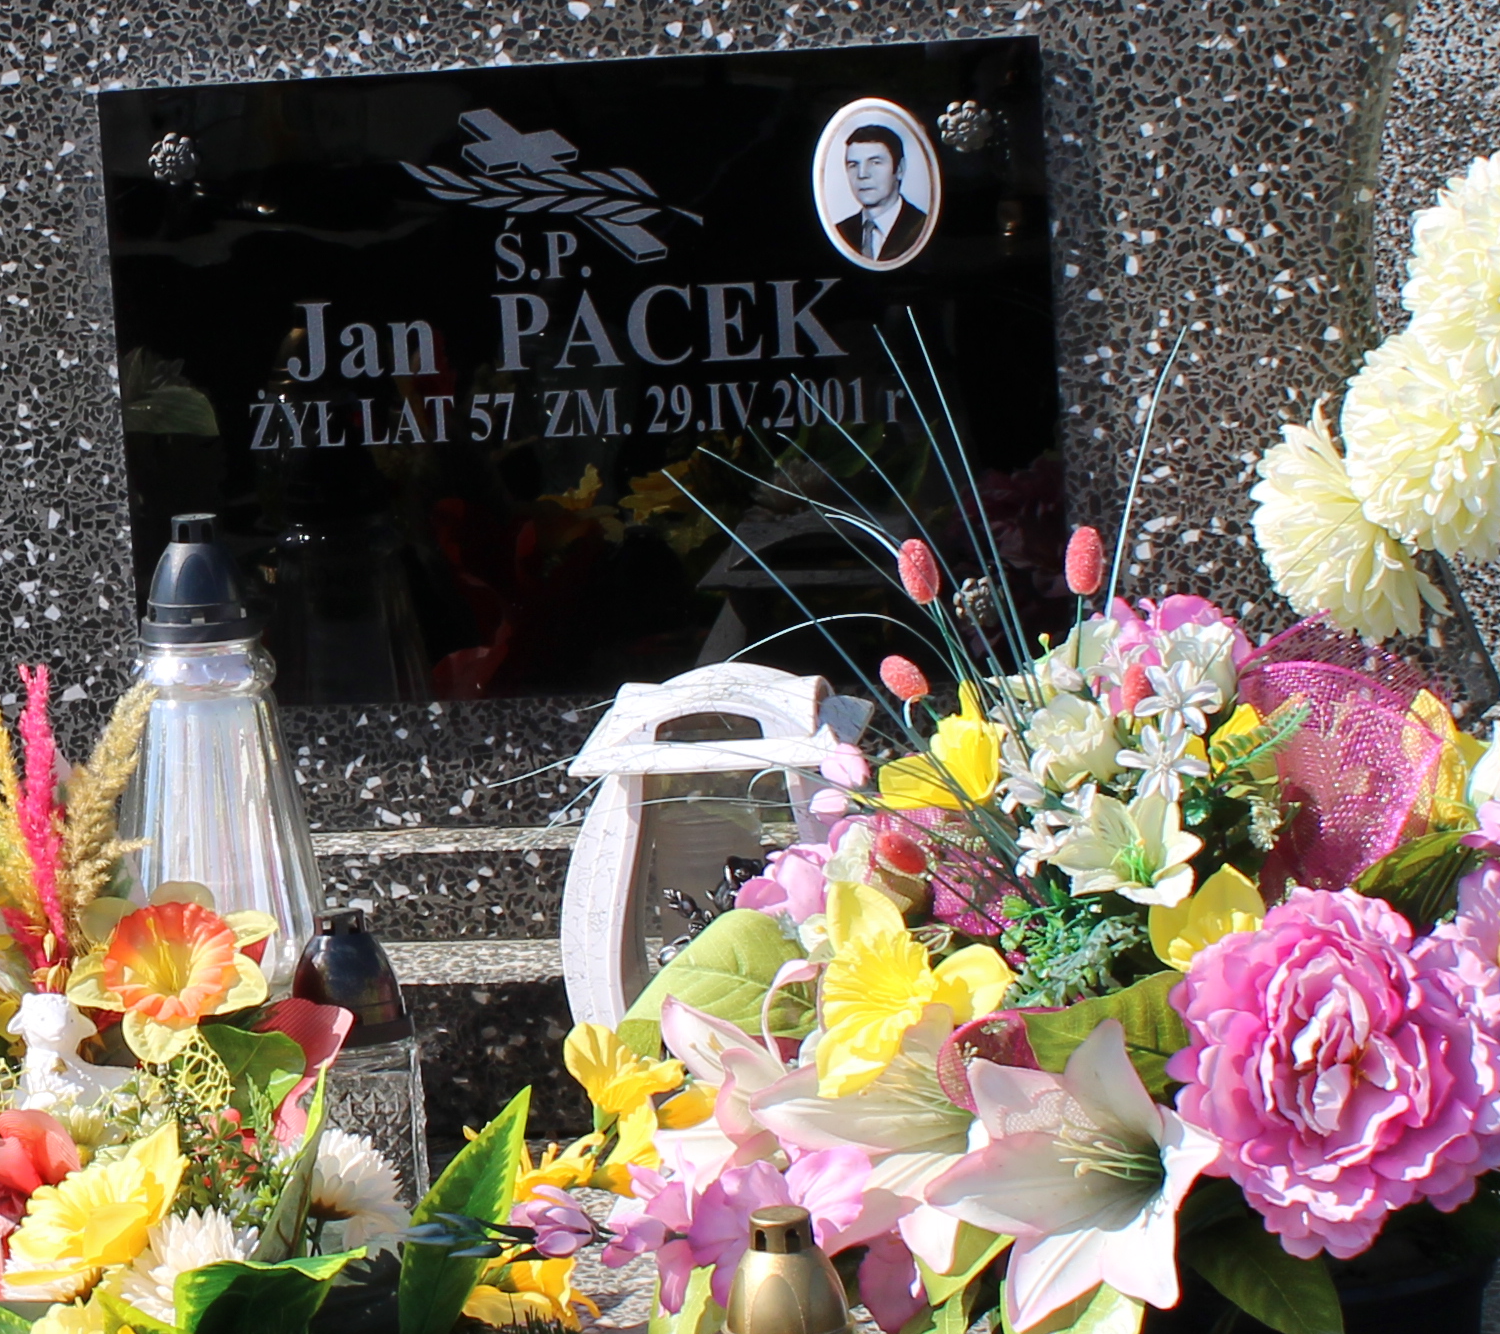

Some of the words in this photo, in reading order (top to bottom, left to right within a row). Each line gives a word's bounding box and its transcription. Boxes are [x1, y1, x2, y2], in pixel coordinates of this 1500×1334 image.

[493, 216, 593, 283] Ś.P.
[286, 300, 440, 382] Jan
[491, 277, 850, 372] PACEK
[249, 388, 347, 450] ŻYŁ
[357, 394, 455, 446] LAT
[469, 391, 516, 442] 57
[543, 387, 632, 438] ZM.
[645, 377, 866, 434] 29.IV.2001
